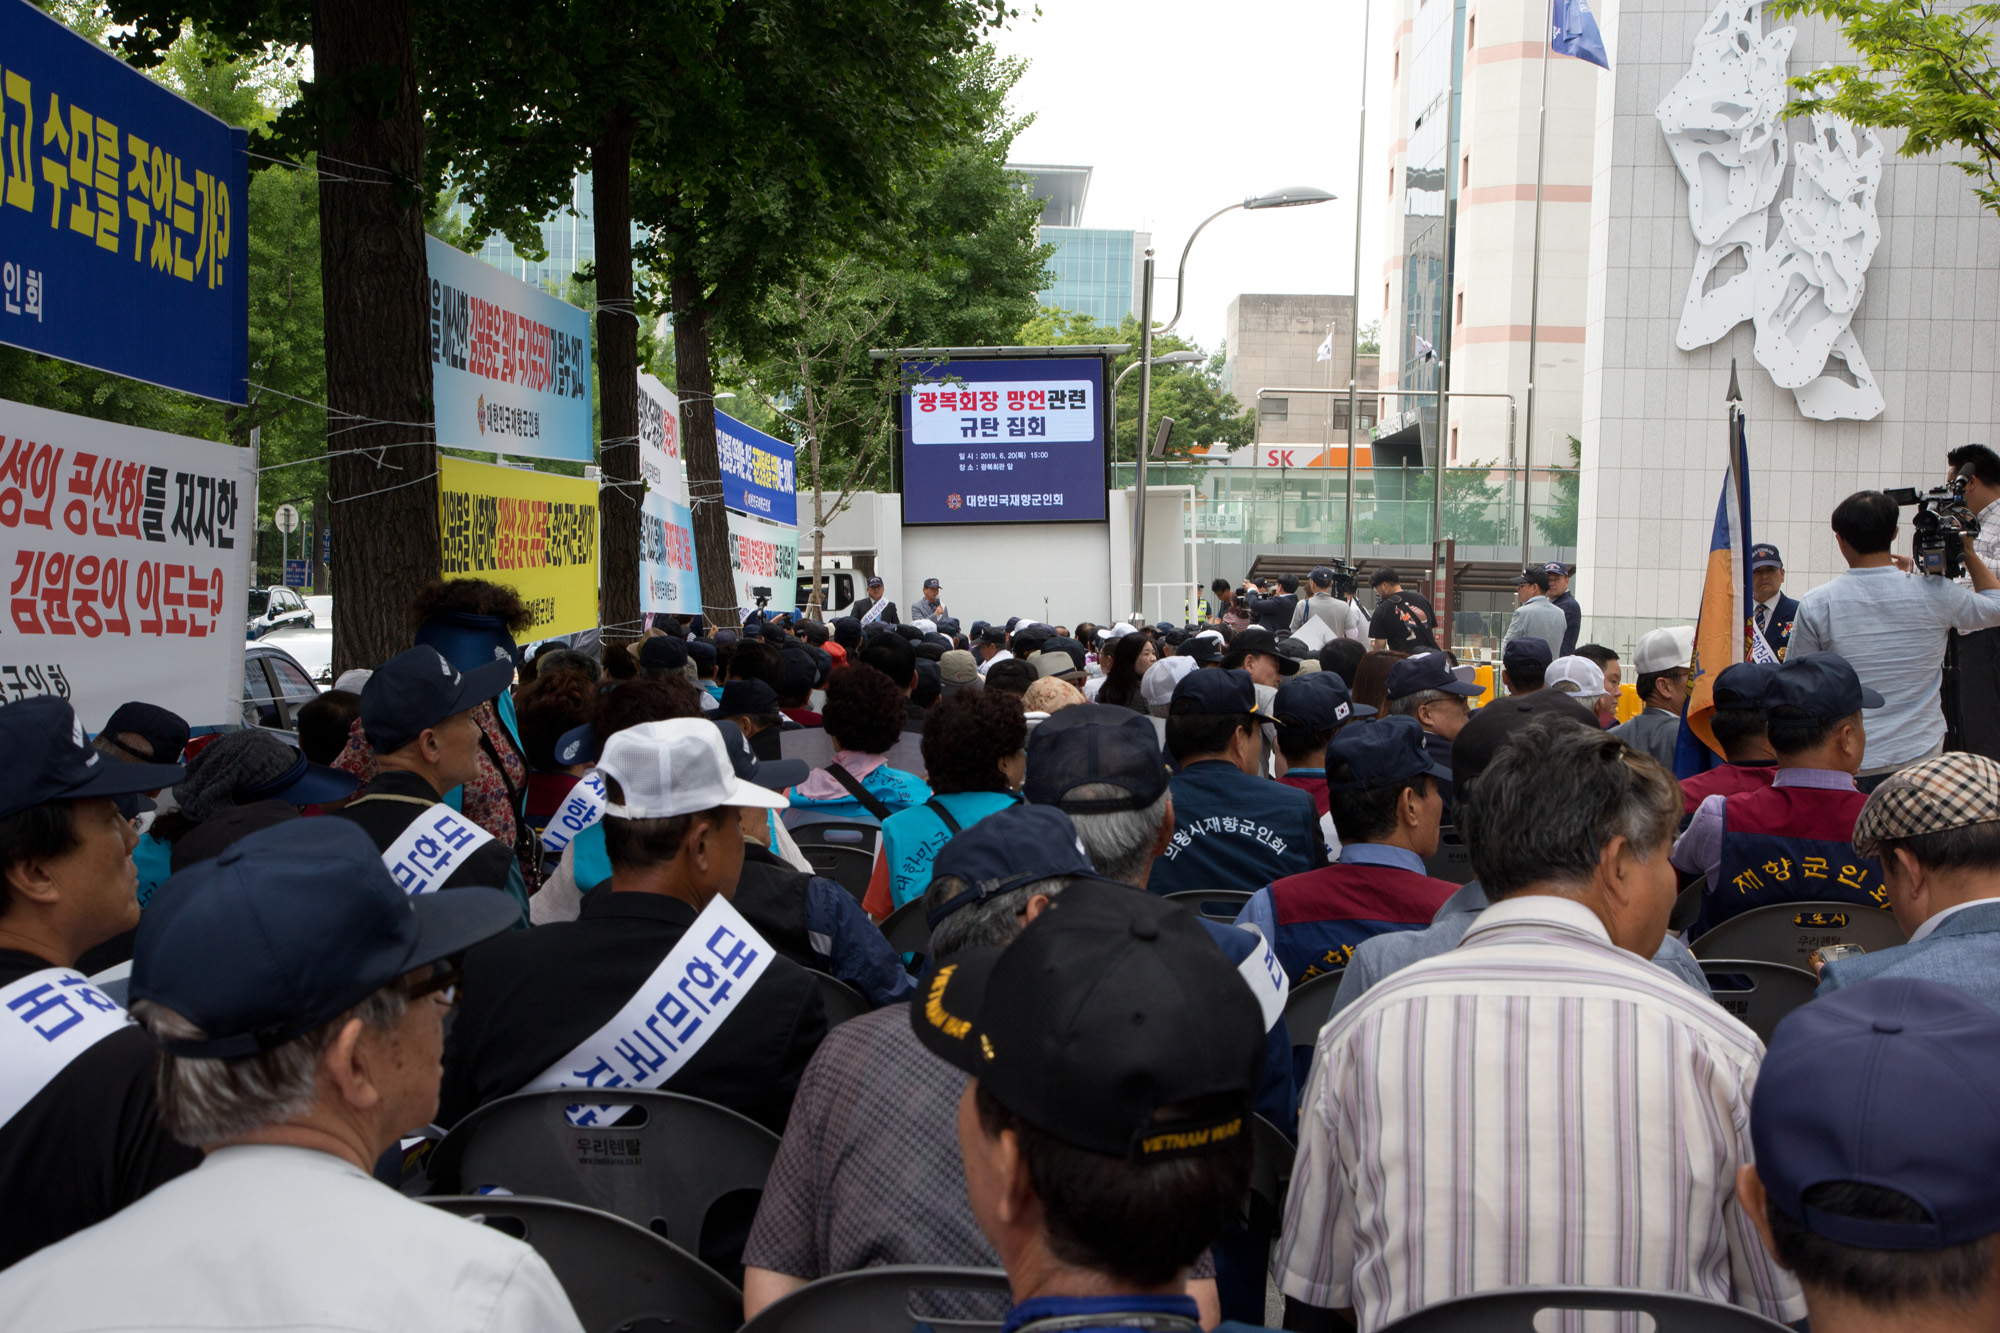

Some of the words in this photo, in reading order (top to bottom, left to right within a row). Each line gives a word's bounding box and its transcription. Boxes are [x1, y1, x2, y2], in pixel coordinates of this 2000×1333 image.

[0, 64, 35, 213] 고
[42, 92, 120, 253] 수모를
[127, 133, 230, 290] 주었는가?
[442, 284, 469, 371] 배신한
[469, 296, 501, 380] 김원봉은
[501, 309, 518, 385] 절대
[518, 315, 558, 394] 국가유공자가
[919, 391, 999, 412] 광복회장
[1007, 389, 1086, 411] 망언관련
[487, 403, 540, 439] 대한민국재향군인회
[960, 417, 999, 438] 규탄
[1007, 416, 1045, 437] 집회
[1268, 450, 1293, 467] SK
[63, 451, 168, 542] 공산화를
[171, 472, 238, 549] 저지한
[966, 493, 1063, 507] 대한민국재향군인회
[442, 490, 470, 574] 김원봉을
[10, 550, 131, 638] 김원웅의
[136, 560, 224, 637] 의도는?
[1165, 816, 1287, 861] 의왕시재향군인회
[577, 1139, 642, 1156] 우리렌탈
[1142, 1133, 1209, 1154] VIETNAM
[1211, 1118, 1242, 1142] WAR
